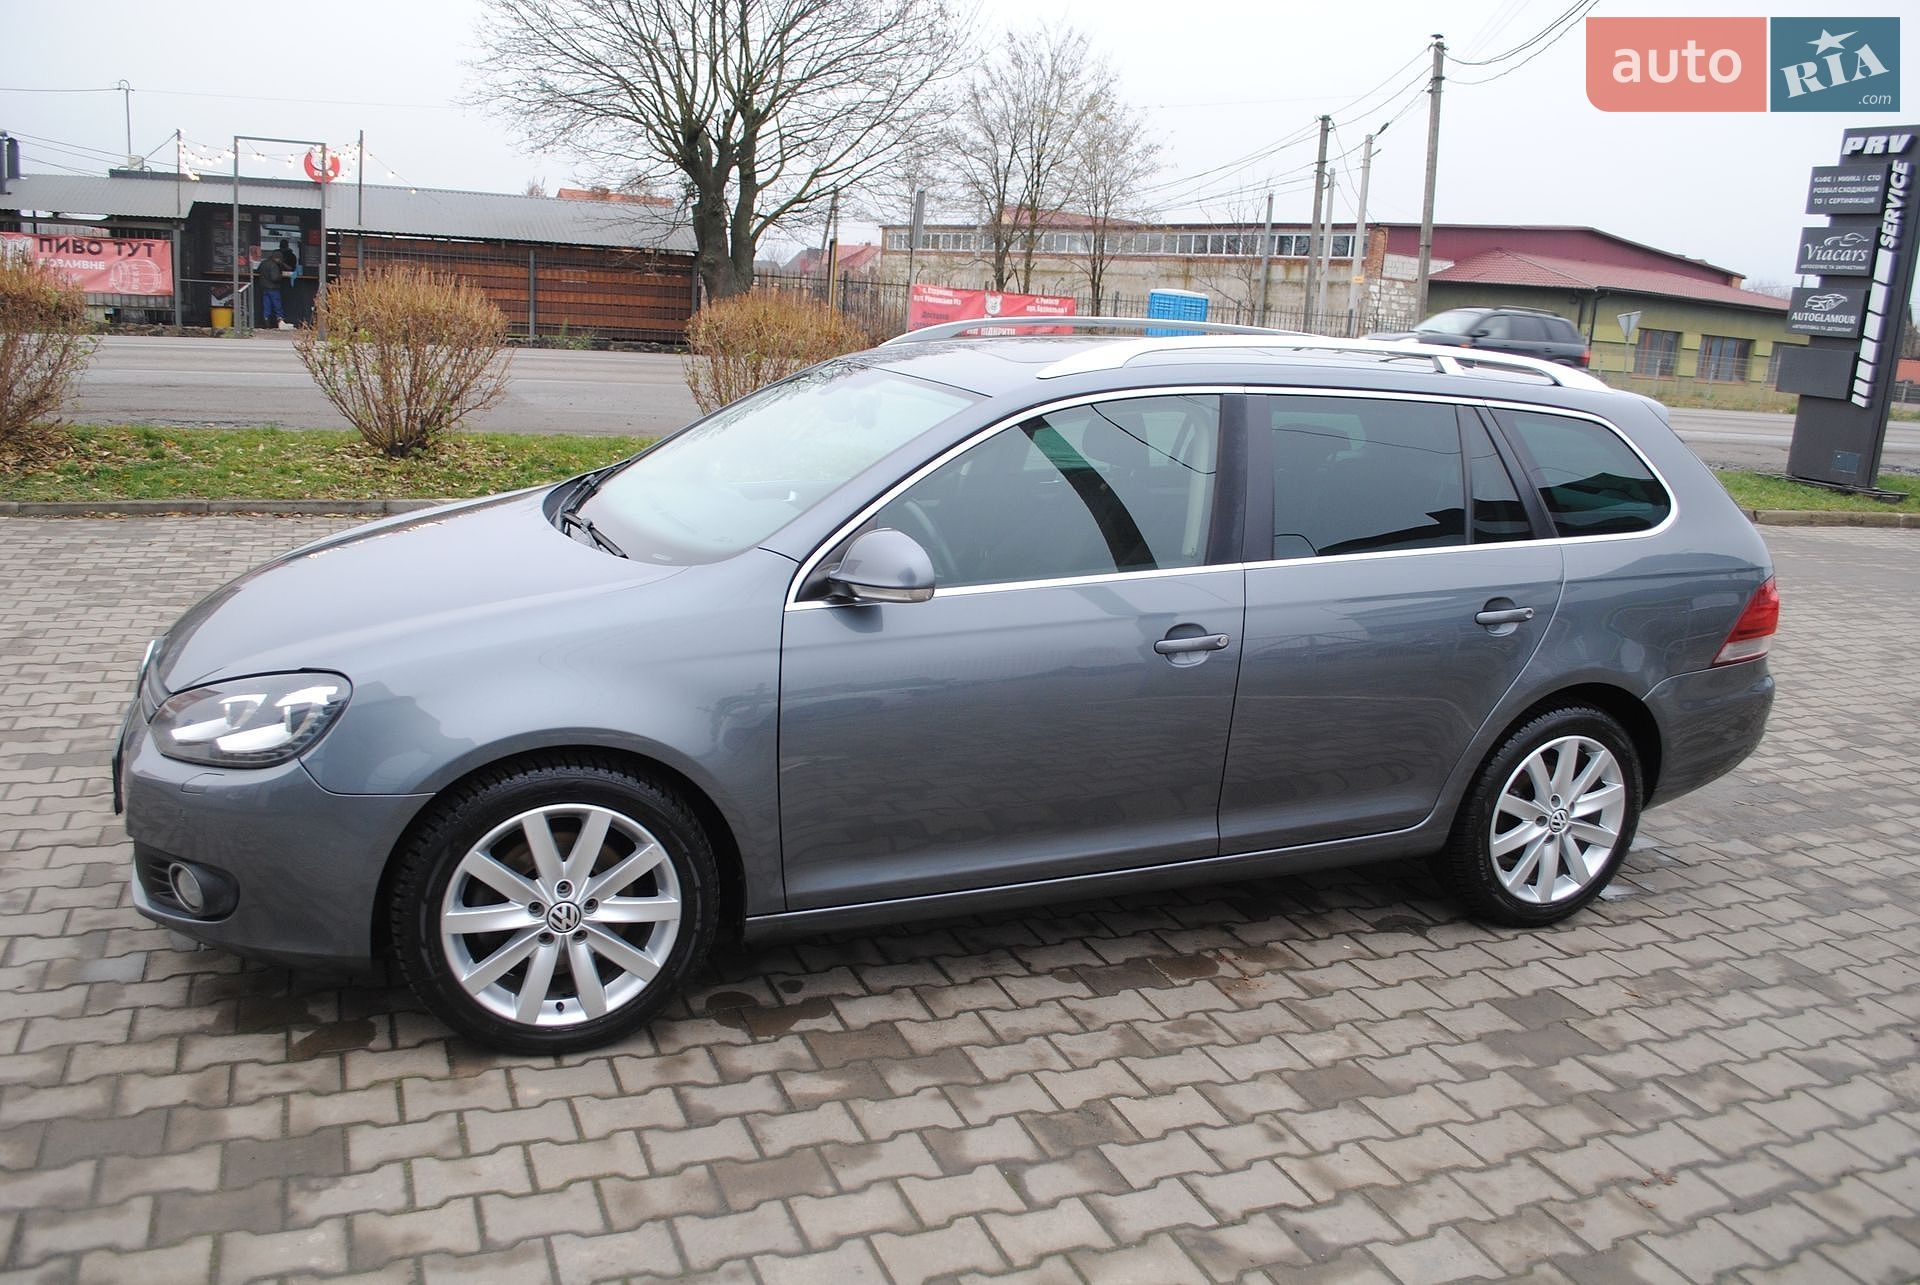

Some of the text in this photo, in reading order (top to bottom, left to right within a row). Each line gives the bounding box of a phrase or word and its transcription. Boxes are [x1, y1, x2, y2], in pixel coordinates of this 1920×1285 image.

[1842, 134, 1913, 155] PRV
[1867, 174, 1881, 182] СТО
[1879, 159, 1910, 249] SERVICE
[39, 238, 156, 258] ПИВО ТУТ
[1804, 243, 1868, 262] Viacars
[1791, 312, 1856, 325] AUTOGLAMOUR
